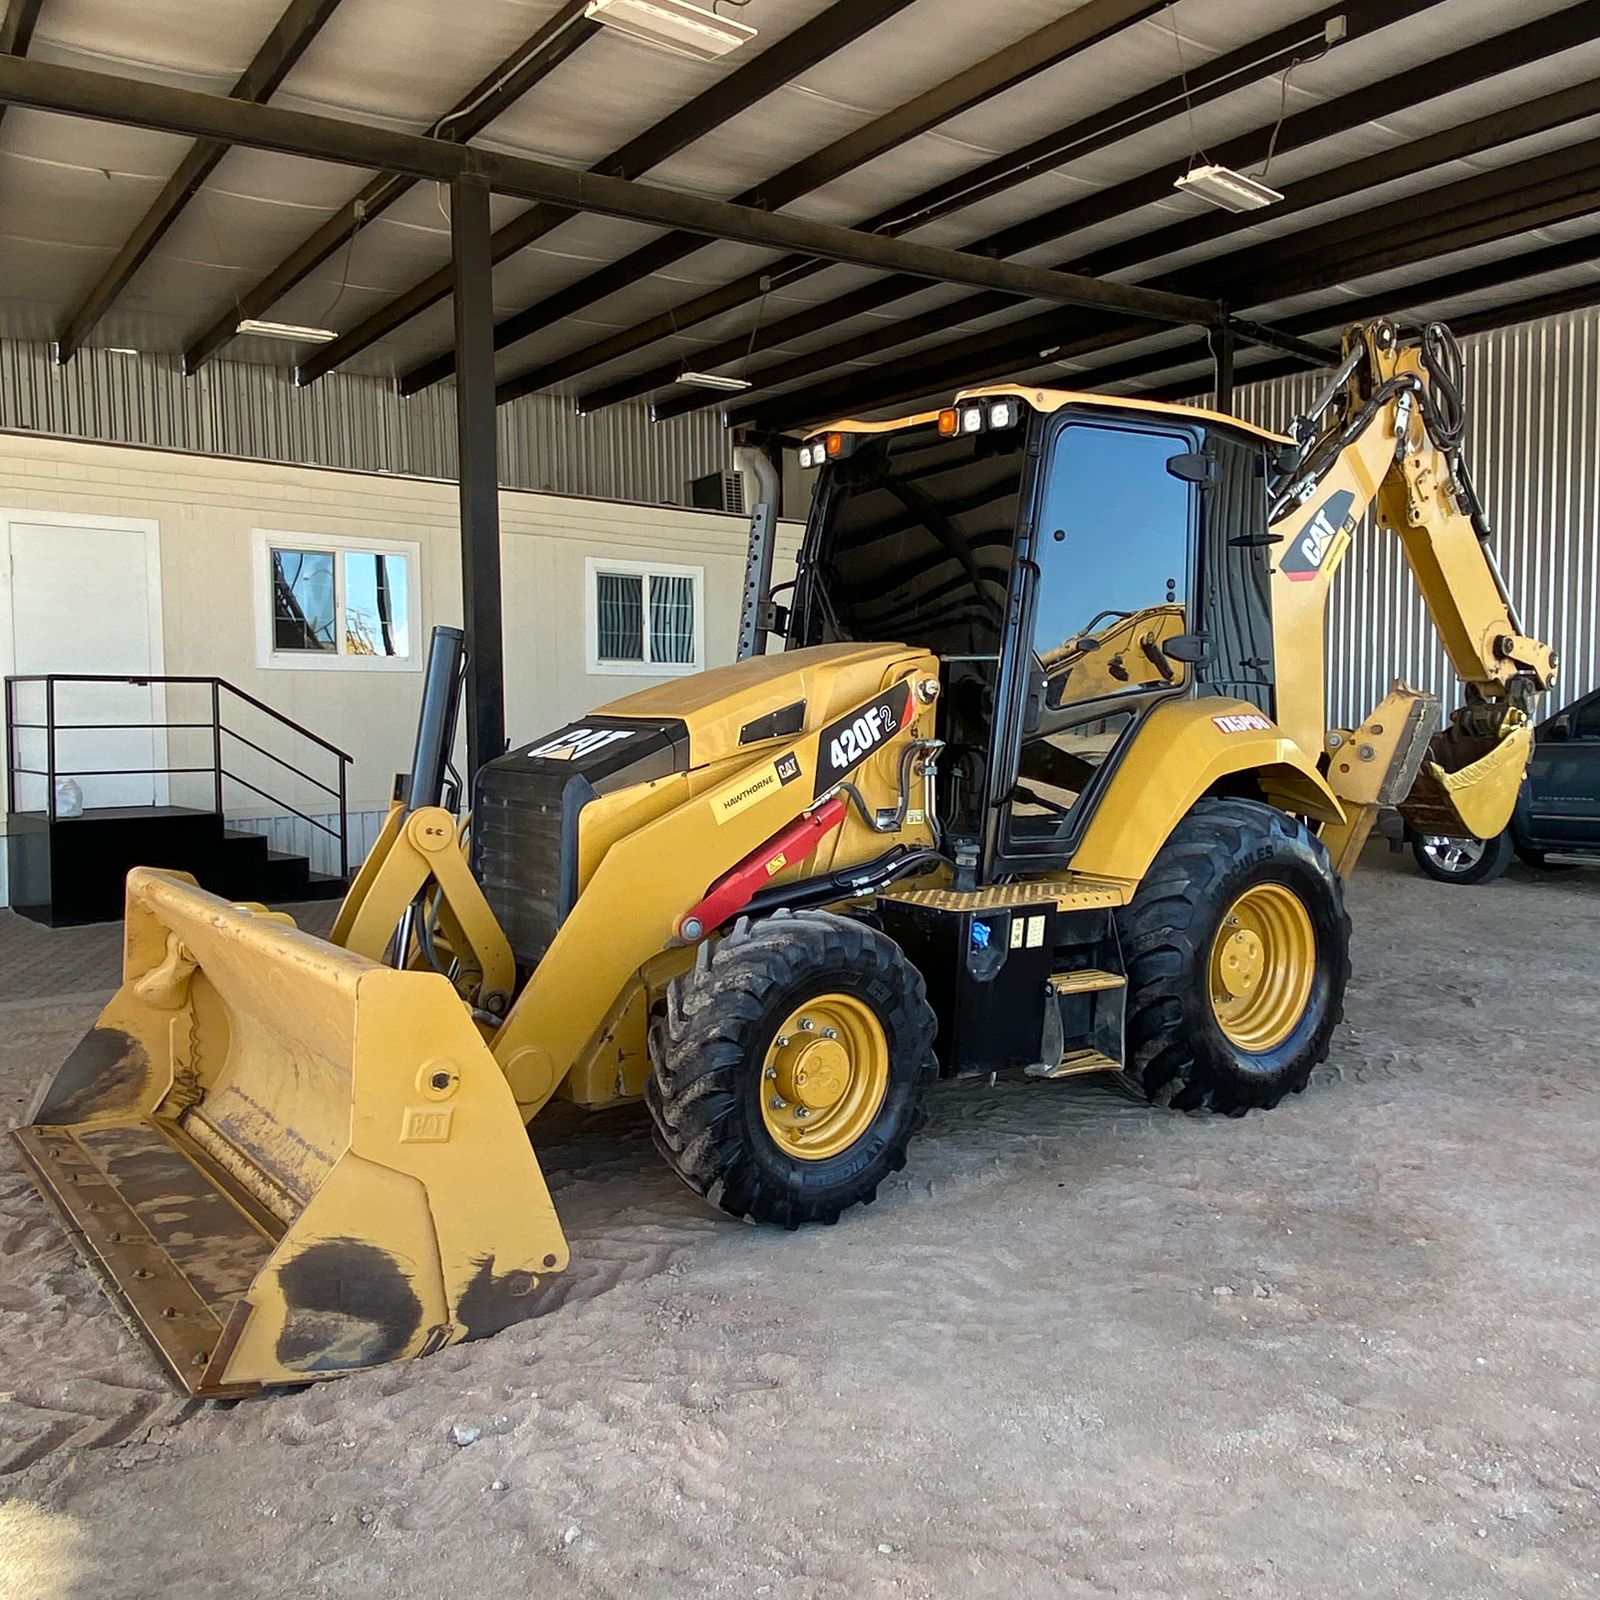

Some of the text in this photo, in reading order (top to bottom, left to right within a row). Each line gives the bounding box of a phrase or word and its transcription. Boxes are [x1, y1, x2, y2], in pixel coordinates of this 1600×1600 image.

[1301, 508, 1336, 567] CAT
[527, 728, 636, 761] CAT
[723, 758, 797, 809] HAWTHORNE CAT
